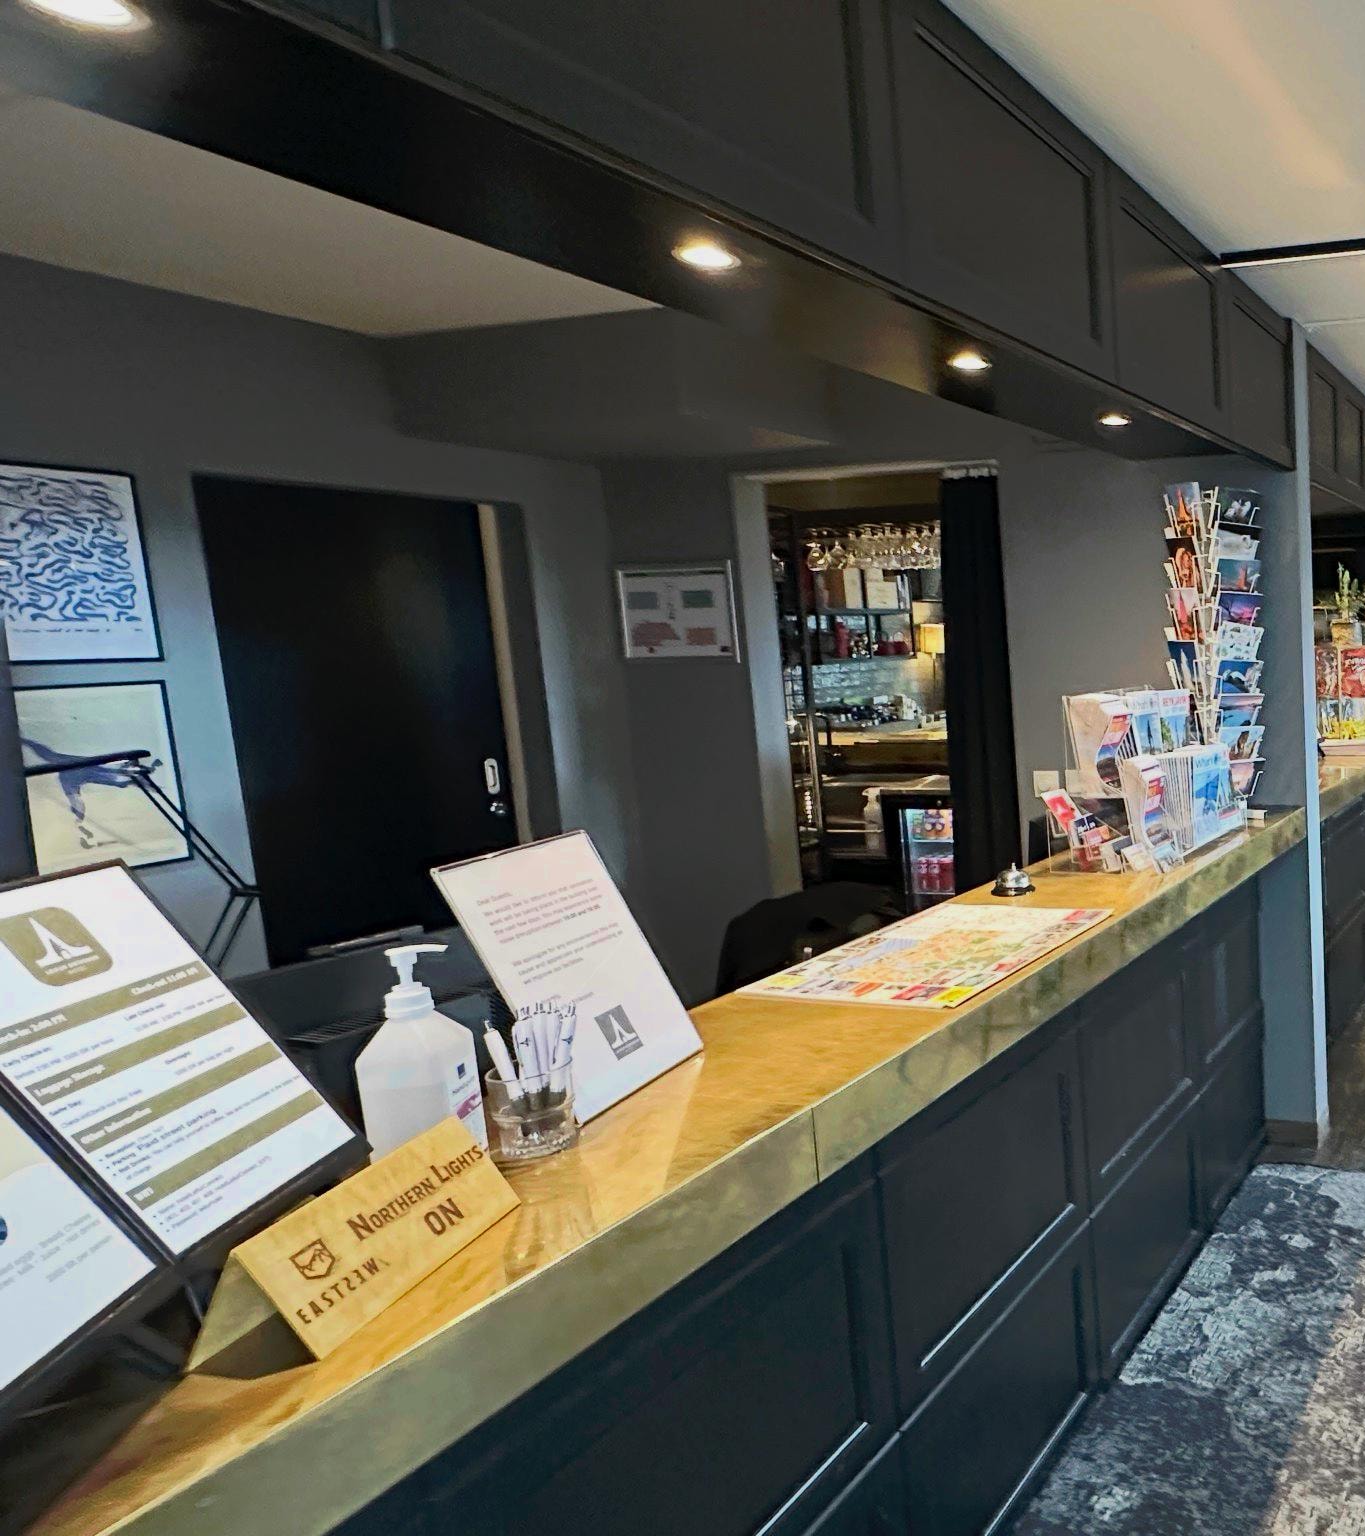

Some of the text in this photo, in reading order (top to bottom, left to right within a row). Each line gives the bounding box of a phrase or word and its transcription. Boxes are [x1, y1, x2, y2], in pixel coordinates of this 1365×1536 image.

[346, 1144, 485, 1242] NORTHERN LIGHTS
[423, 1197, 465, 1236] ON
